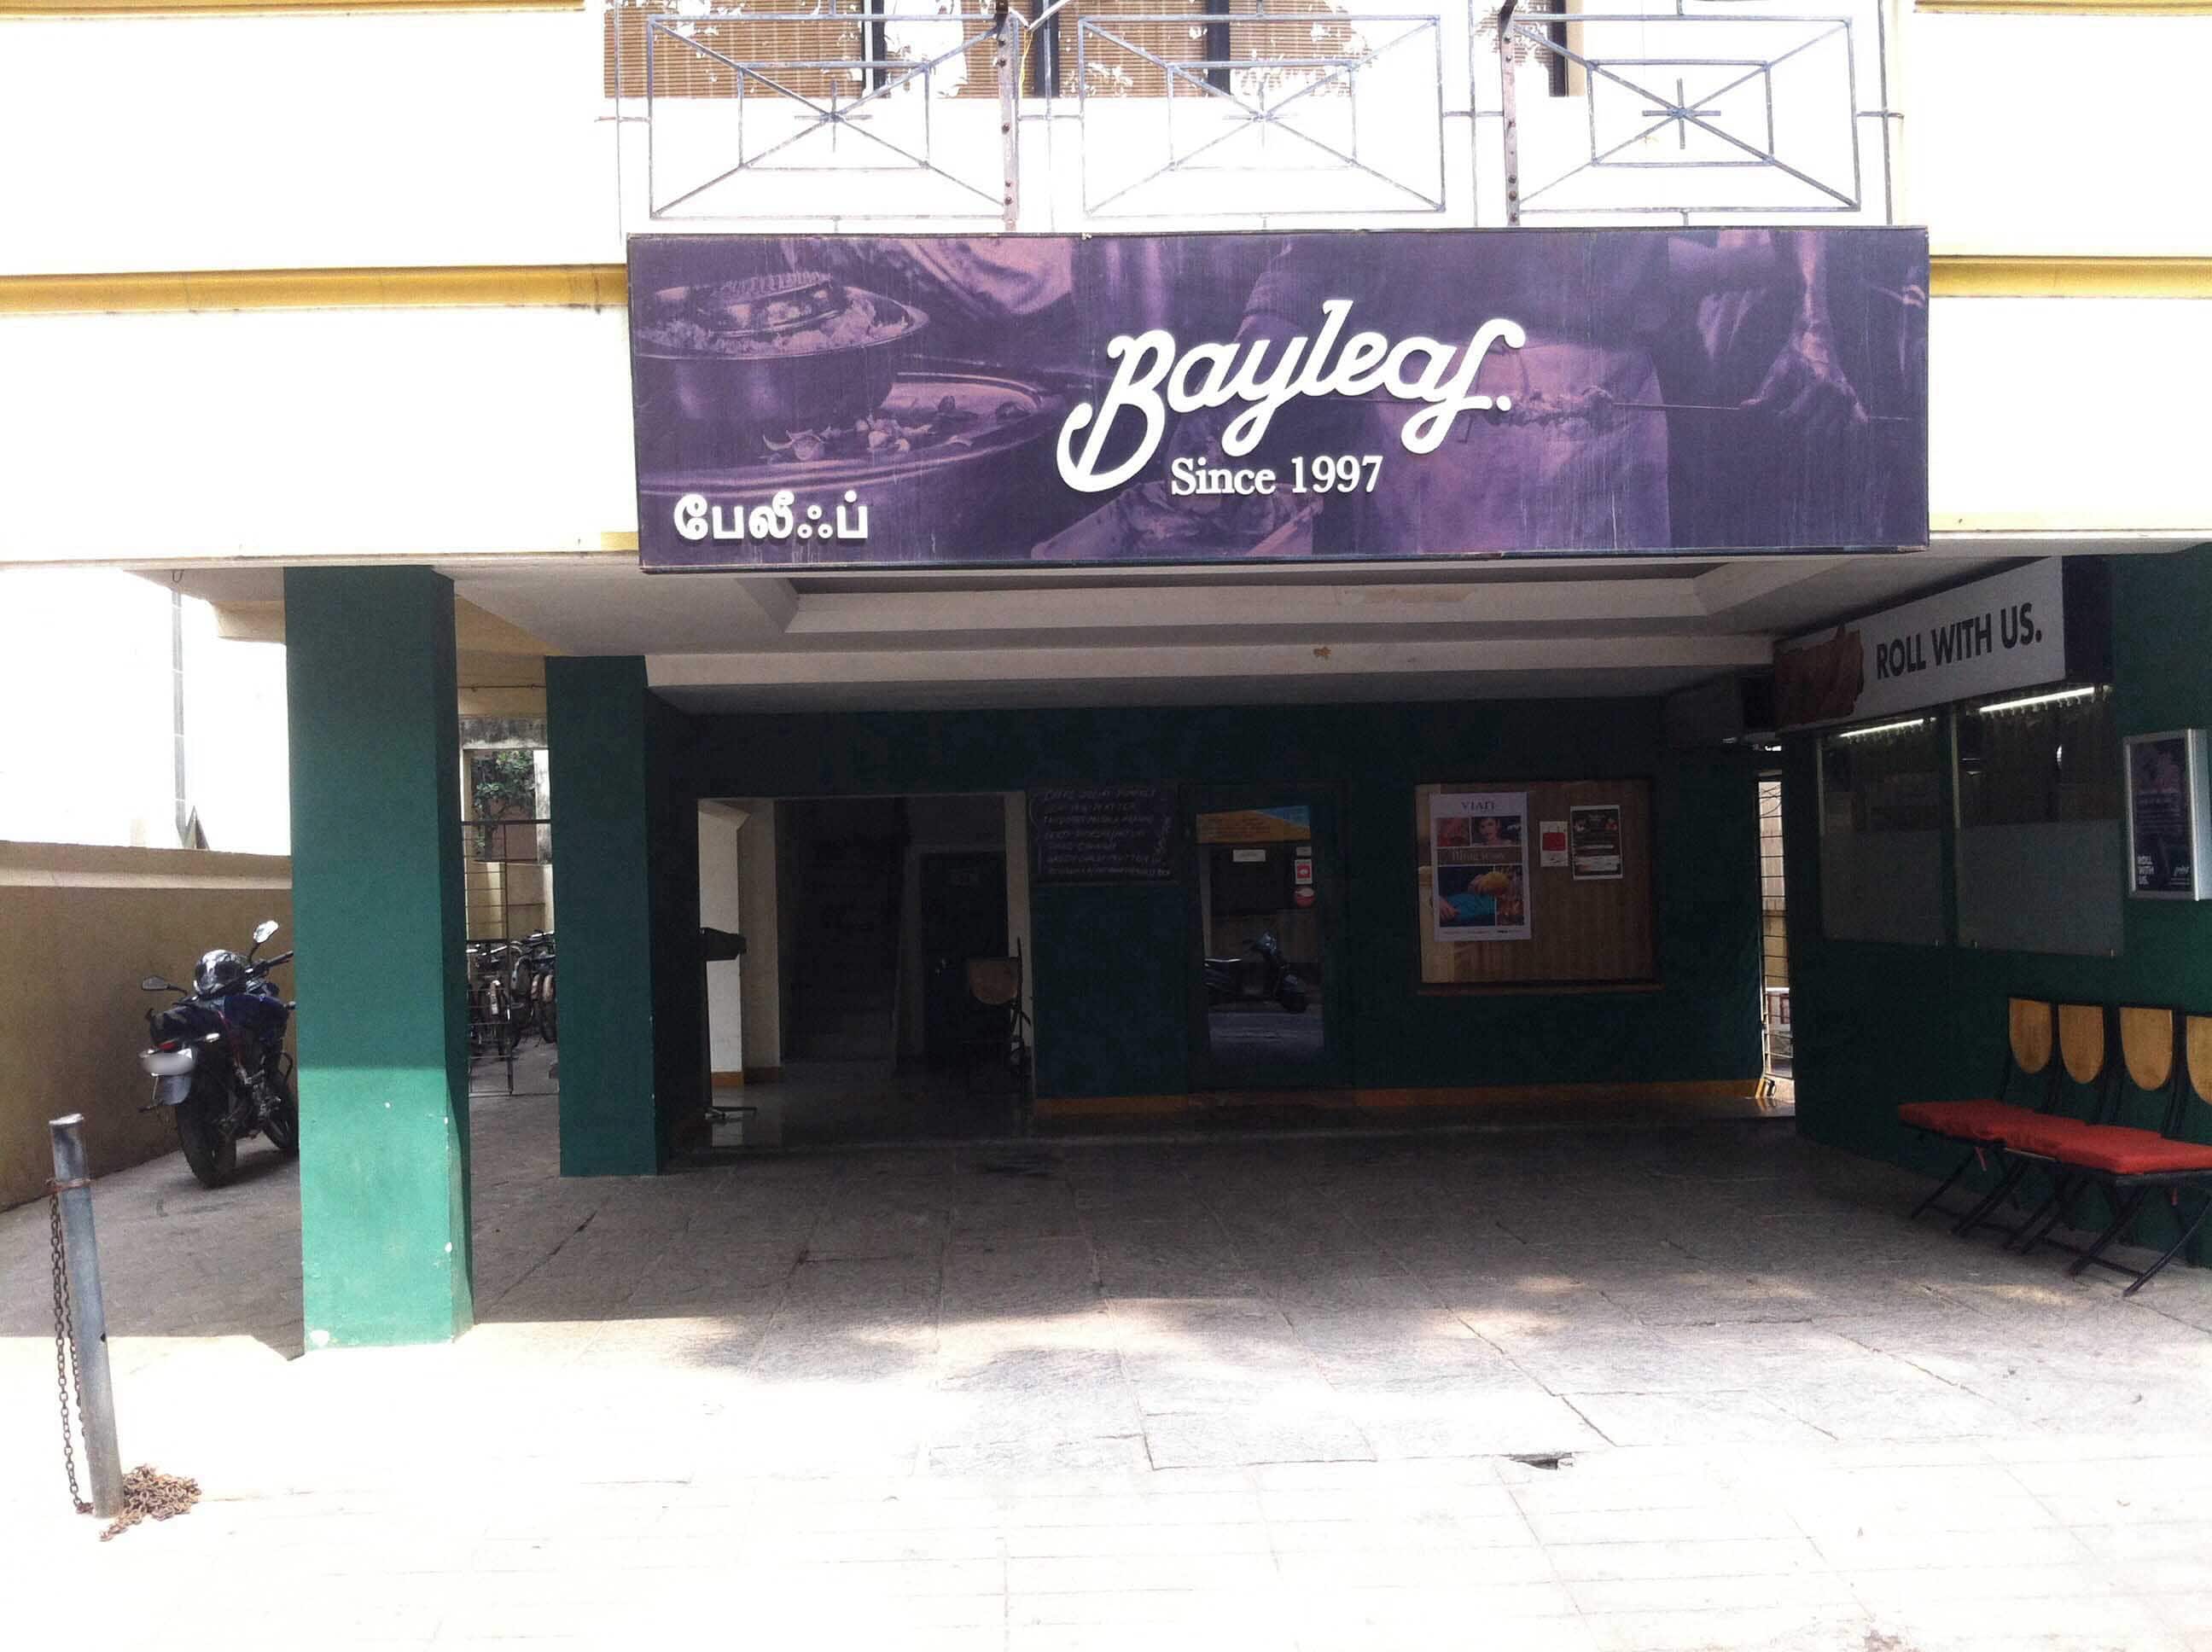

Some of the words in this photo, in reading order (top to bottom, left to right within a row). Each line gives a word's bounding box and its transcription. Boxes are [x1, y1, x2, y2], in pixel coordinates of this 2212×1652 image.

[1170, 457, 1277, 497] Since
[1290, 456, 1384, 494] 1997
[673, 489, 869, 541] பேலீஃப்
[1877, 633, 1927, 679] ROLL
[1931, 614, 1993, 666] WITH
[2000, 602, 2043, 649] US.
